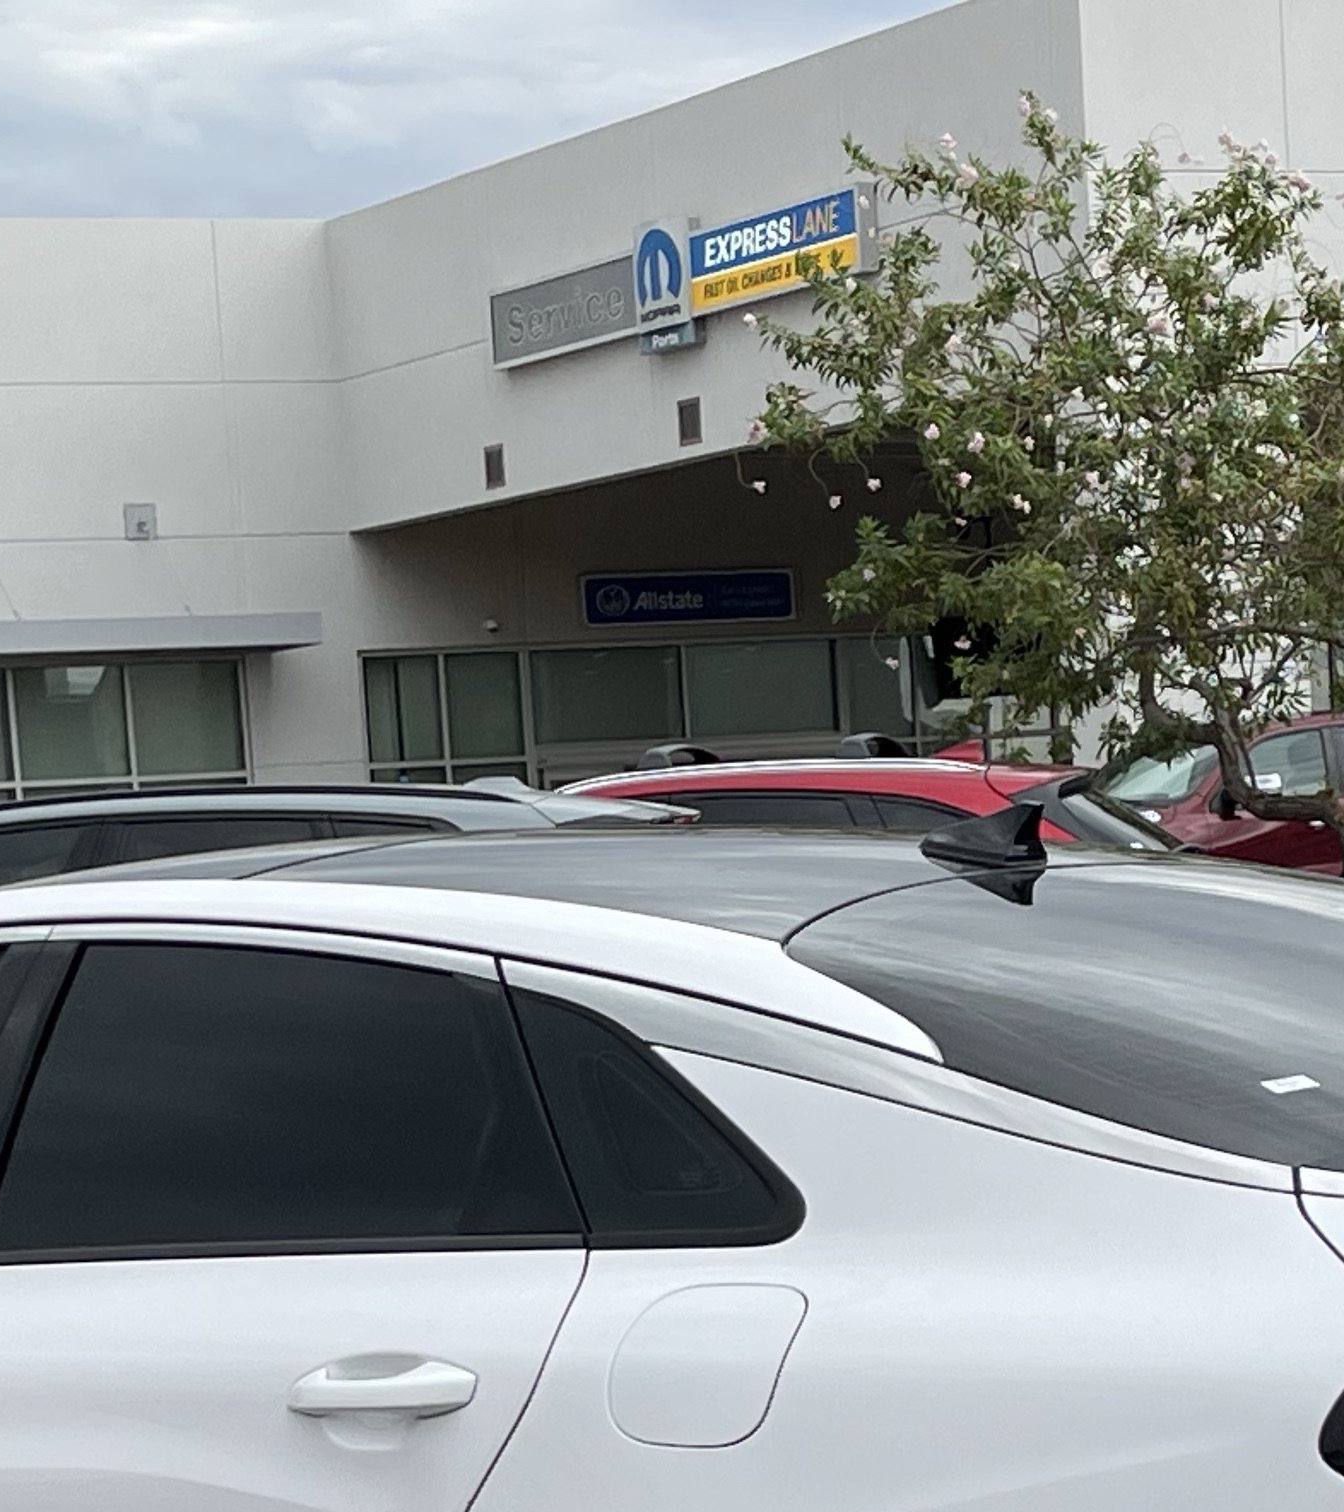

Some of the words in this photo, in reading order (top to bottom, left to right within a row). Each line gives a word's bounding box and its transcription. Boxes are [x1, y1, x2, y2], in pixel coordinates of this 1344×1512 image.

[742, 263, 783, 290] CHANGES
[508, 286, 625, 346] Service
[651, 332, 680, 349] Parts
[633, 590, 704, 610] Allstate
